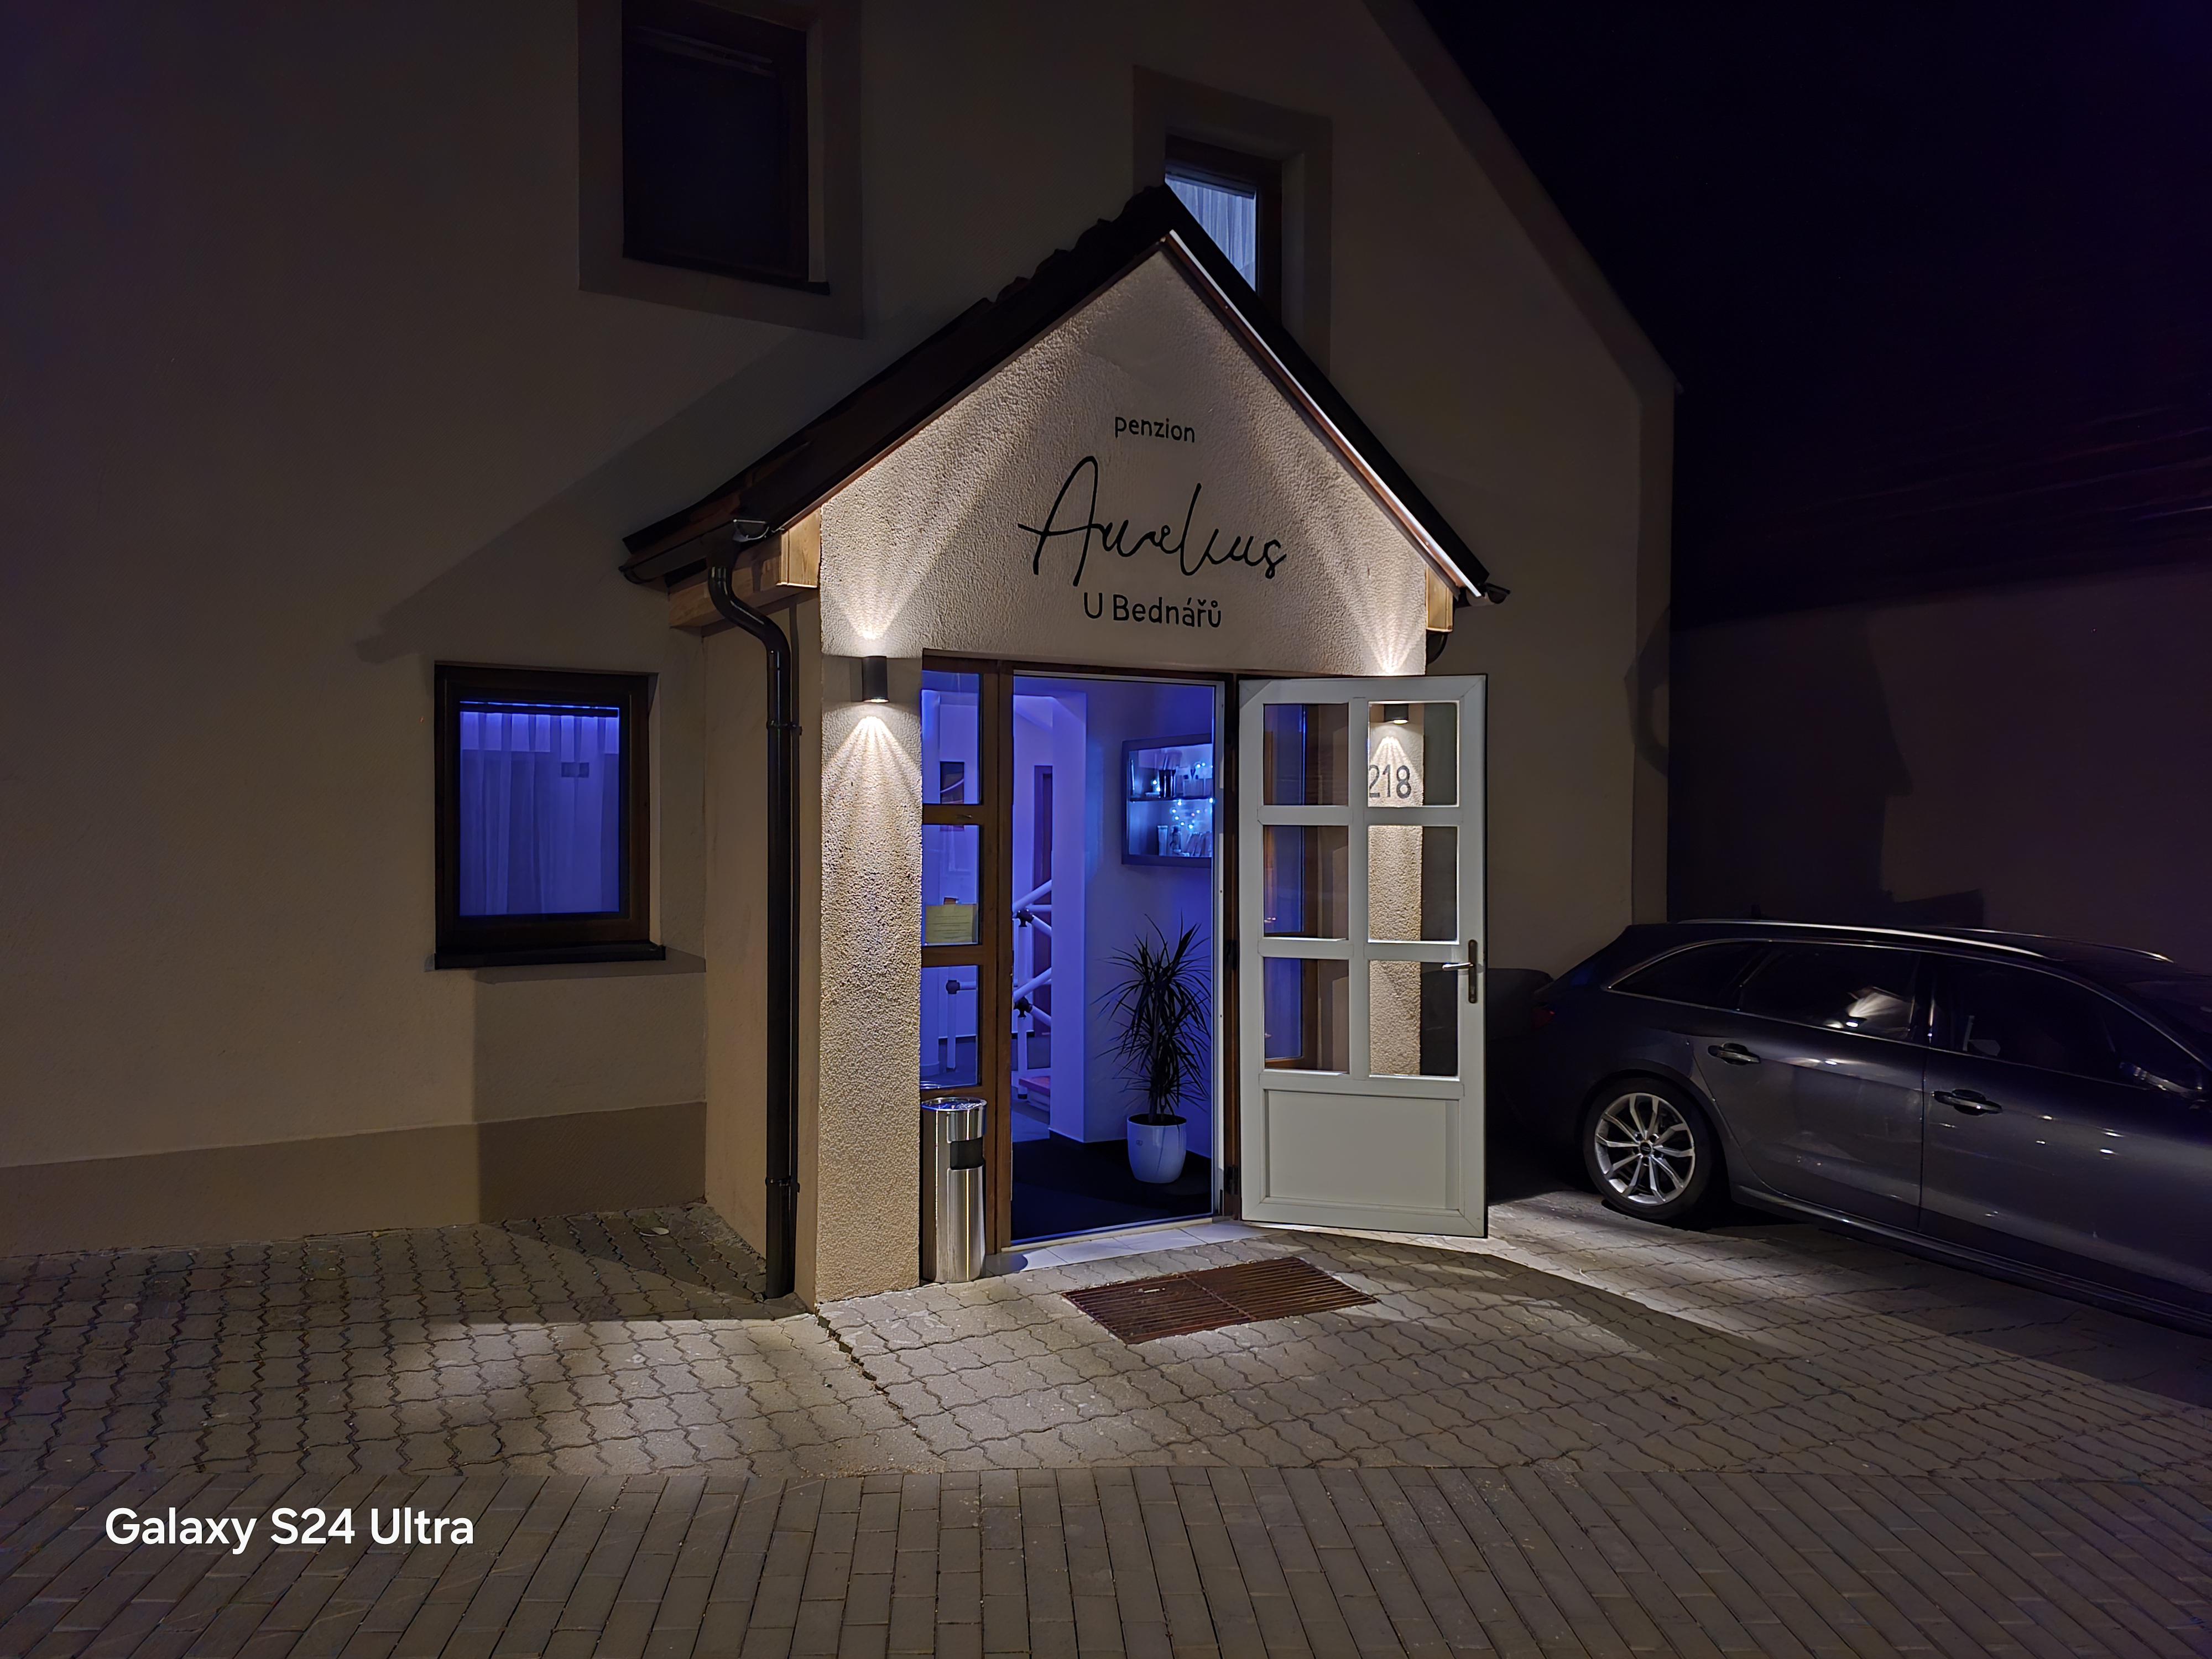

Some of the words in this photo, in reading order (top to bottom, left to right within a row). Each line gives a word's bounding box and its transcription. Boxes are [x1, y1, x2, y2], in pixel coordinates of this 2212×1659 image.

[1114, 416, 1195, 443] penzion
[1083, 592, 1103, 619] U
[1113, 594, 1222, 628] Bednářů
[1369, 764, 1411, 799] 218
